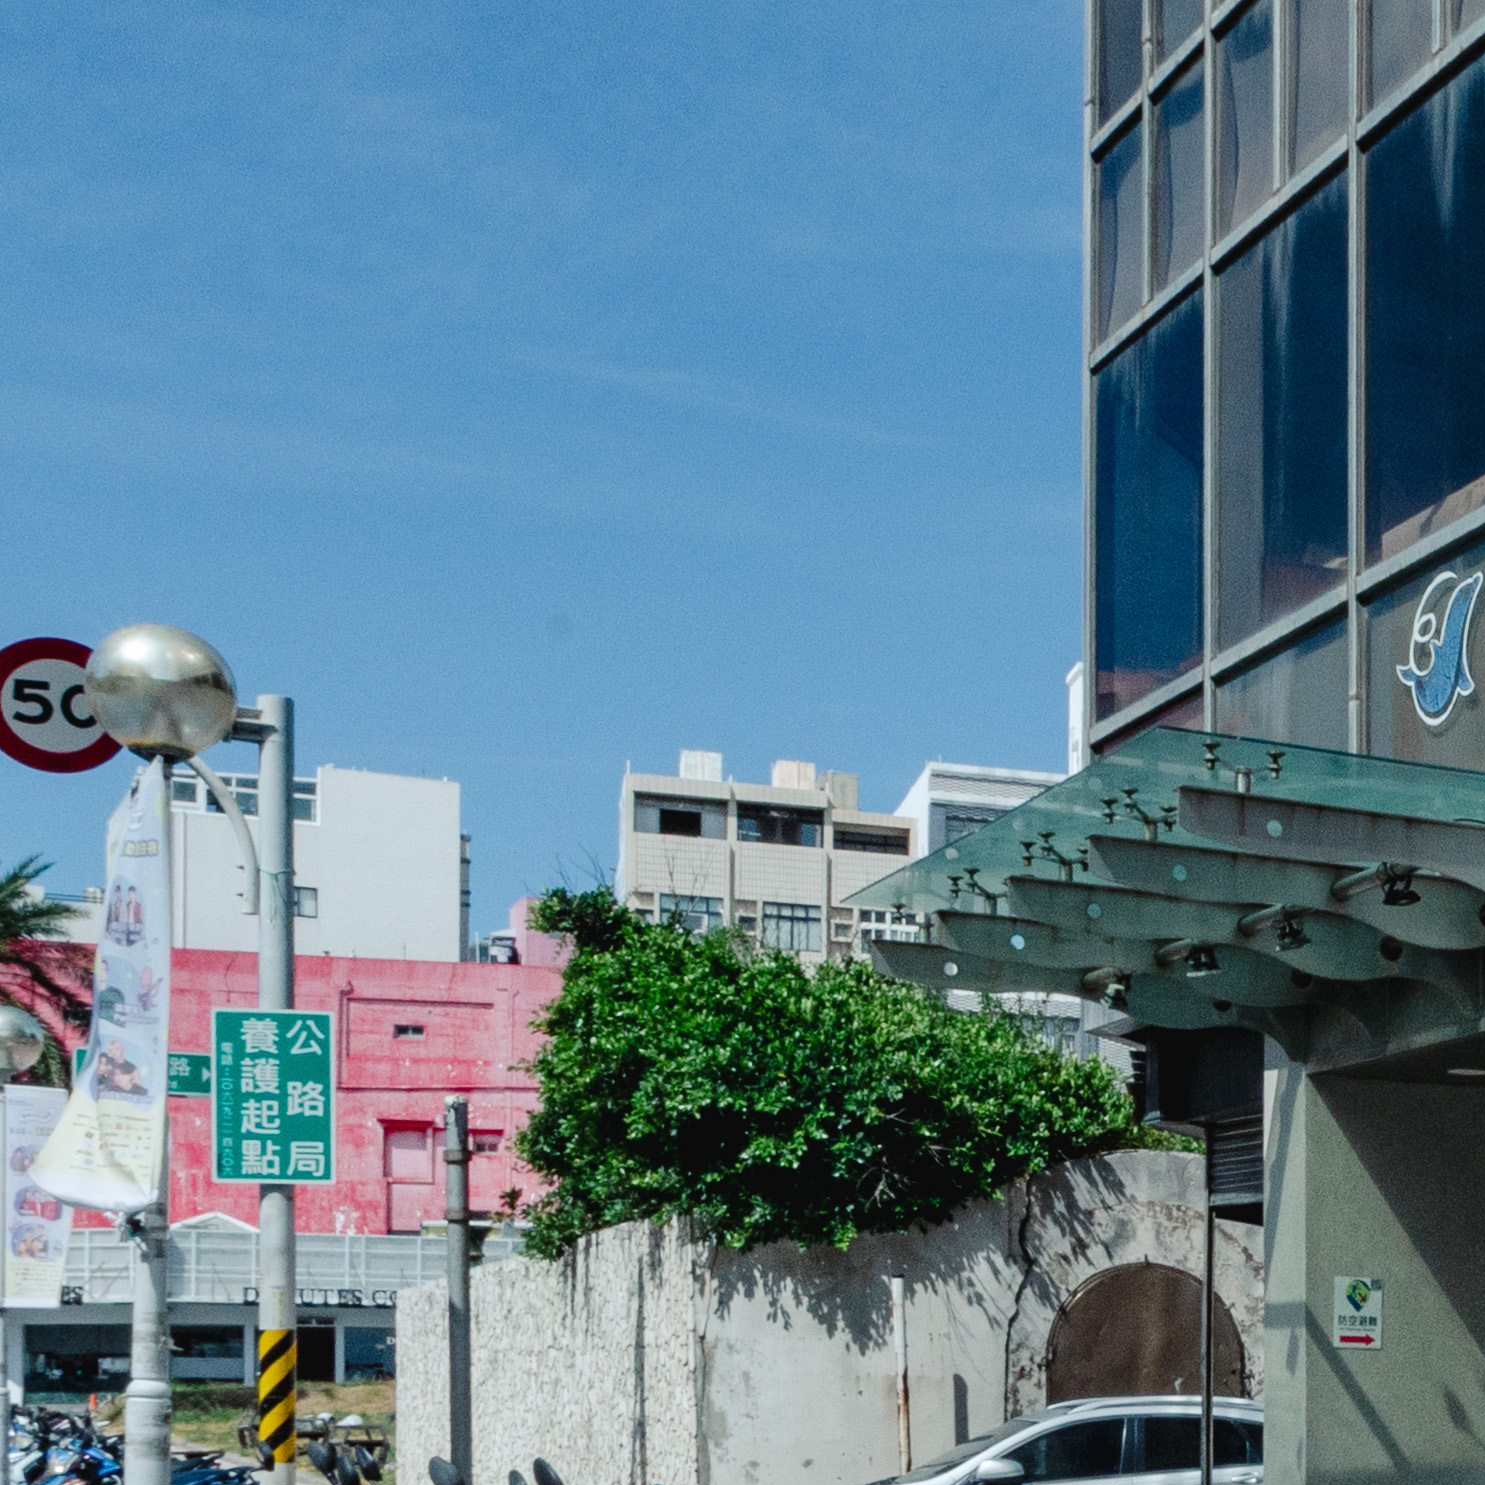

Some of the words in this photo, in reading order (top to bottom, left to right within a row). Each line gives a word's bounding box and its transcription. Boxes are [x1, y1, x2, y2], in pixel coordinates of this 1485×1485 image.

[240, 1017, 281, 1176] 養護起點
[286, 1019, 326, 1177] 公路局
